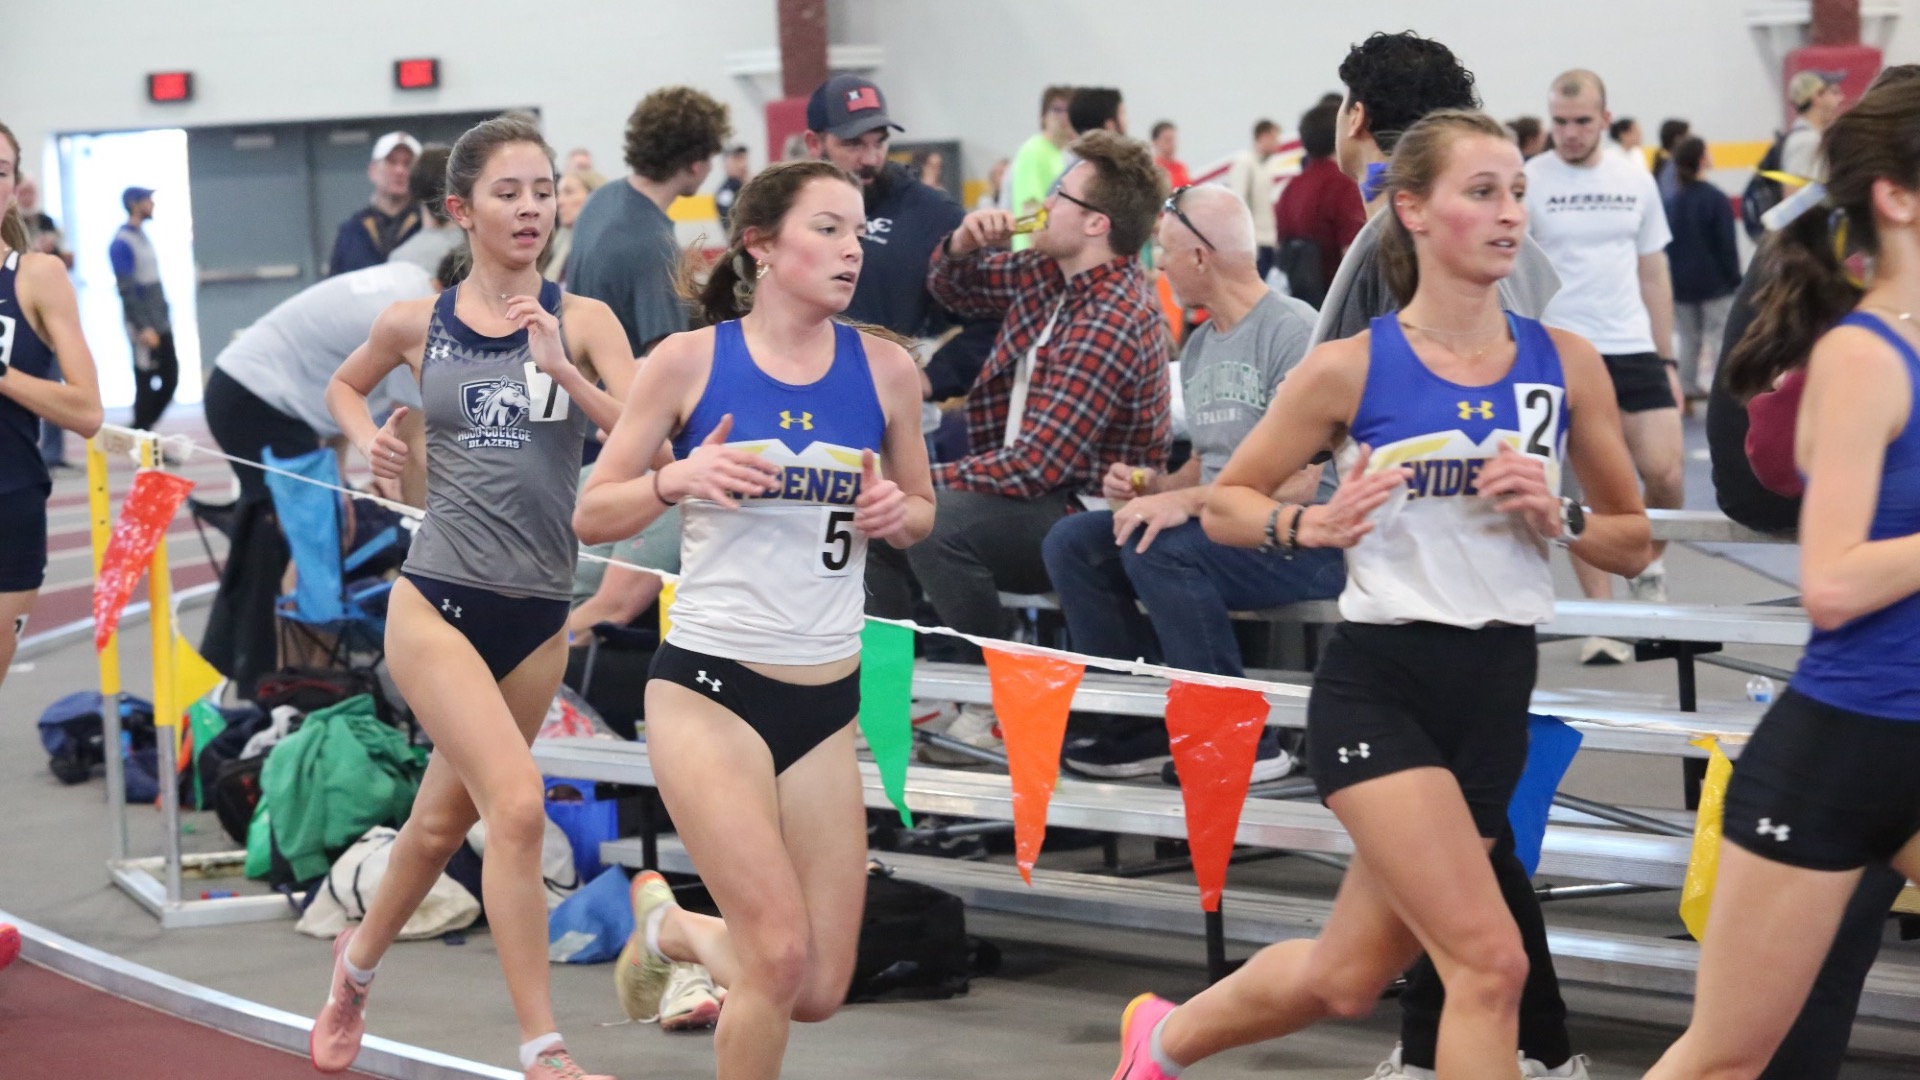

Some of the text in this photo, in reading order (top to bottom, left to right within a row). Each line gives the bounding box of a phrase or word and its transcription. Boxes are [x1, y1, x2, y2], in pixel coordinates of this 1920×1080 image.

[458, 425, 532, 442] HOOD COLLEGE
[1526, 389, 1552, 457] 2
[468, 438, 520, 449] BLAZERS
[822, 511, 854, 570] 5
